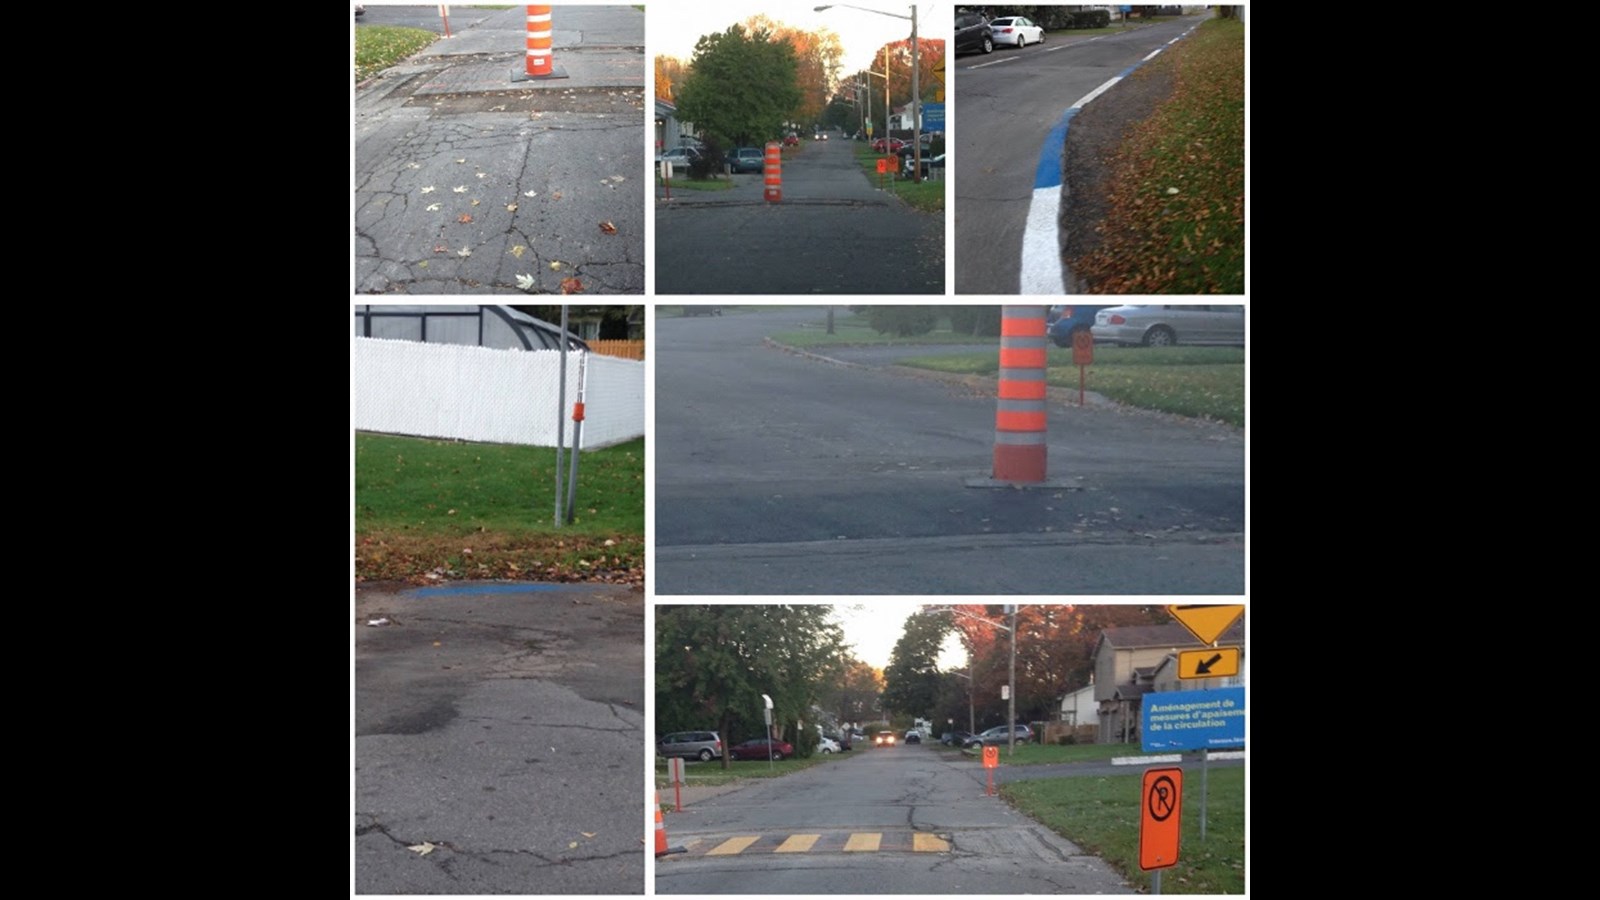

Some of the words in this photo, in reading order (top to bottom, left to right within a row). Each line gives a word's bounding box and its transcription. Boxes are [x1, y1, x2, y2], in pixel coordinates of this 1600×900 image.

[1151, 701, 1221, 713] Aménagement
[1222, 699, 1234, 707] de
[1150, 713, 1190, 722] mesures
[1150, 723, 1162, 731] de
[1163, 722, 1172, 730] la
[1174, 719, 1226, 730] circulation
